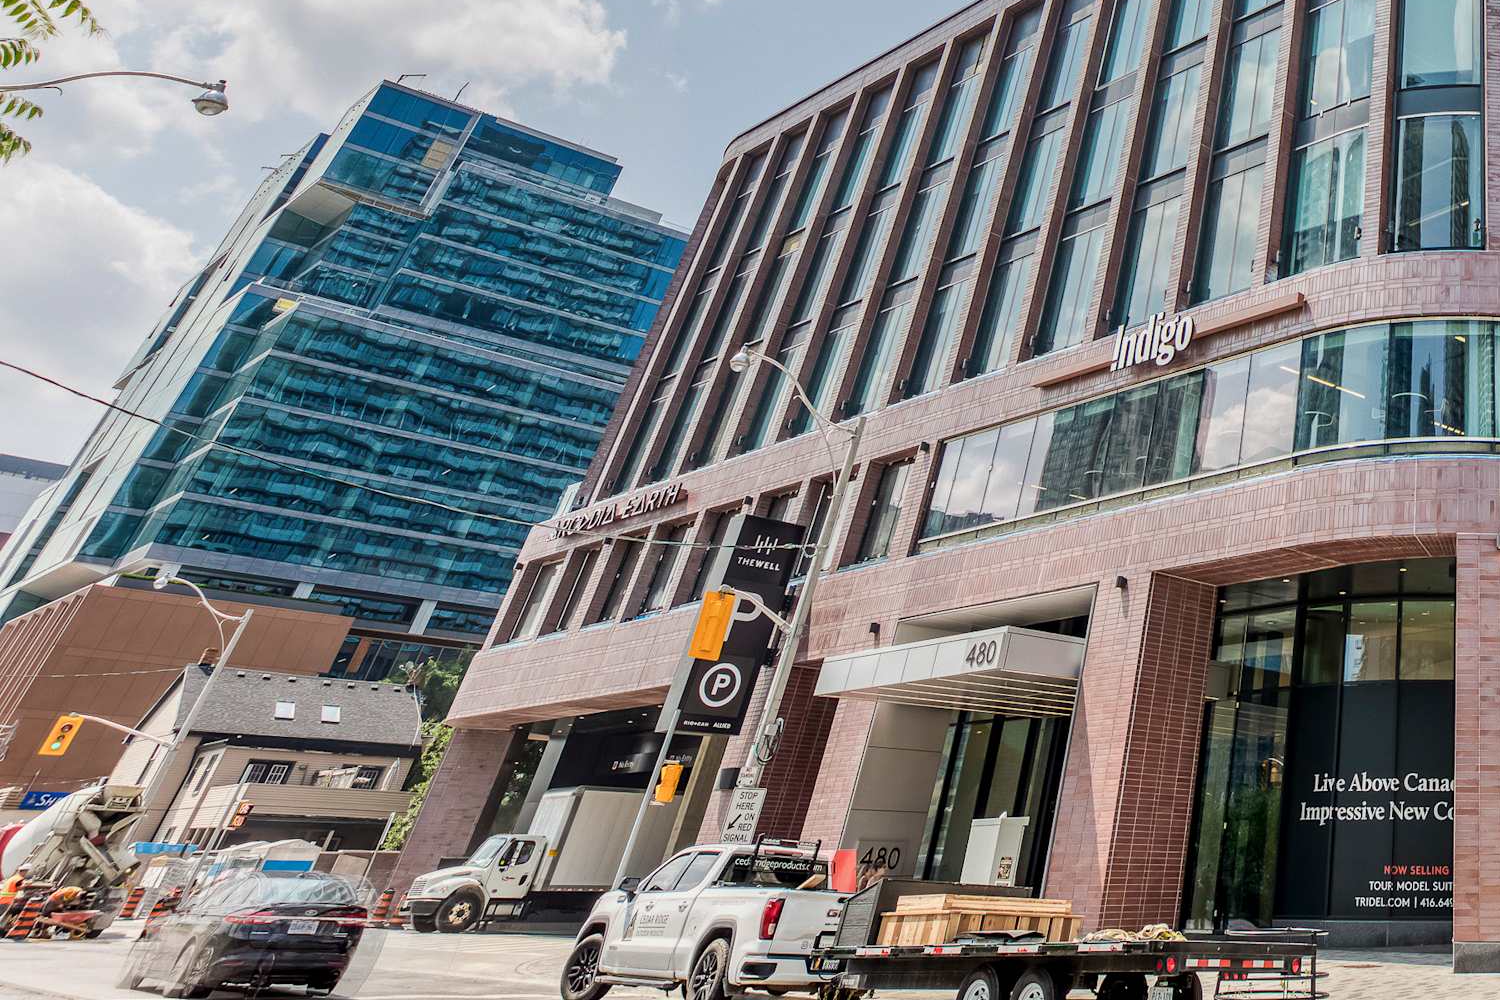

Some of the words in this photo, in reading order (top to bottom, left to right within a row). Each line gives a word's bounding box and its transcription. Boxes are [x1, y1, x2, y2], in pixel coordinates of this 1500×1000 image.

[621, 482, 683, 520] EARTH
[966, 640, 997, 668] 480
[711, 673, 731, 695] P
[1313, 773, 1345, 792] Live
[1348, 772, 1400, 792] Above
[740, 792, 758, 800] STOP
[736, 802, 755, 810] HERE
[1300, 801, 1385, 826] Impressive
[1389, 801, 1430, 821] New
[738, 823, 752, 831] RED
[723, 833, 748, 842] SIGNAL
[860, 846, 900, 870] 480
[1384, 865, 1407, 875] NOW
[1410, 865, 1449, 875] SELLING
[1369, 881, 1393, 891] TOUR
[1397, 881, 1430, 891] MODEL
[1355, 896, 1410, 907] TRIDEL.COM
